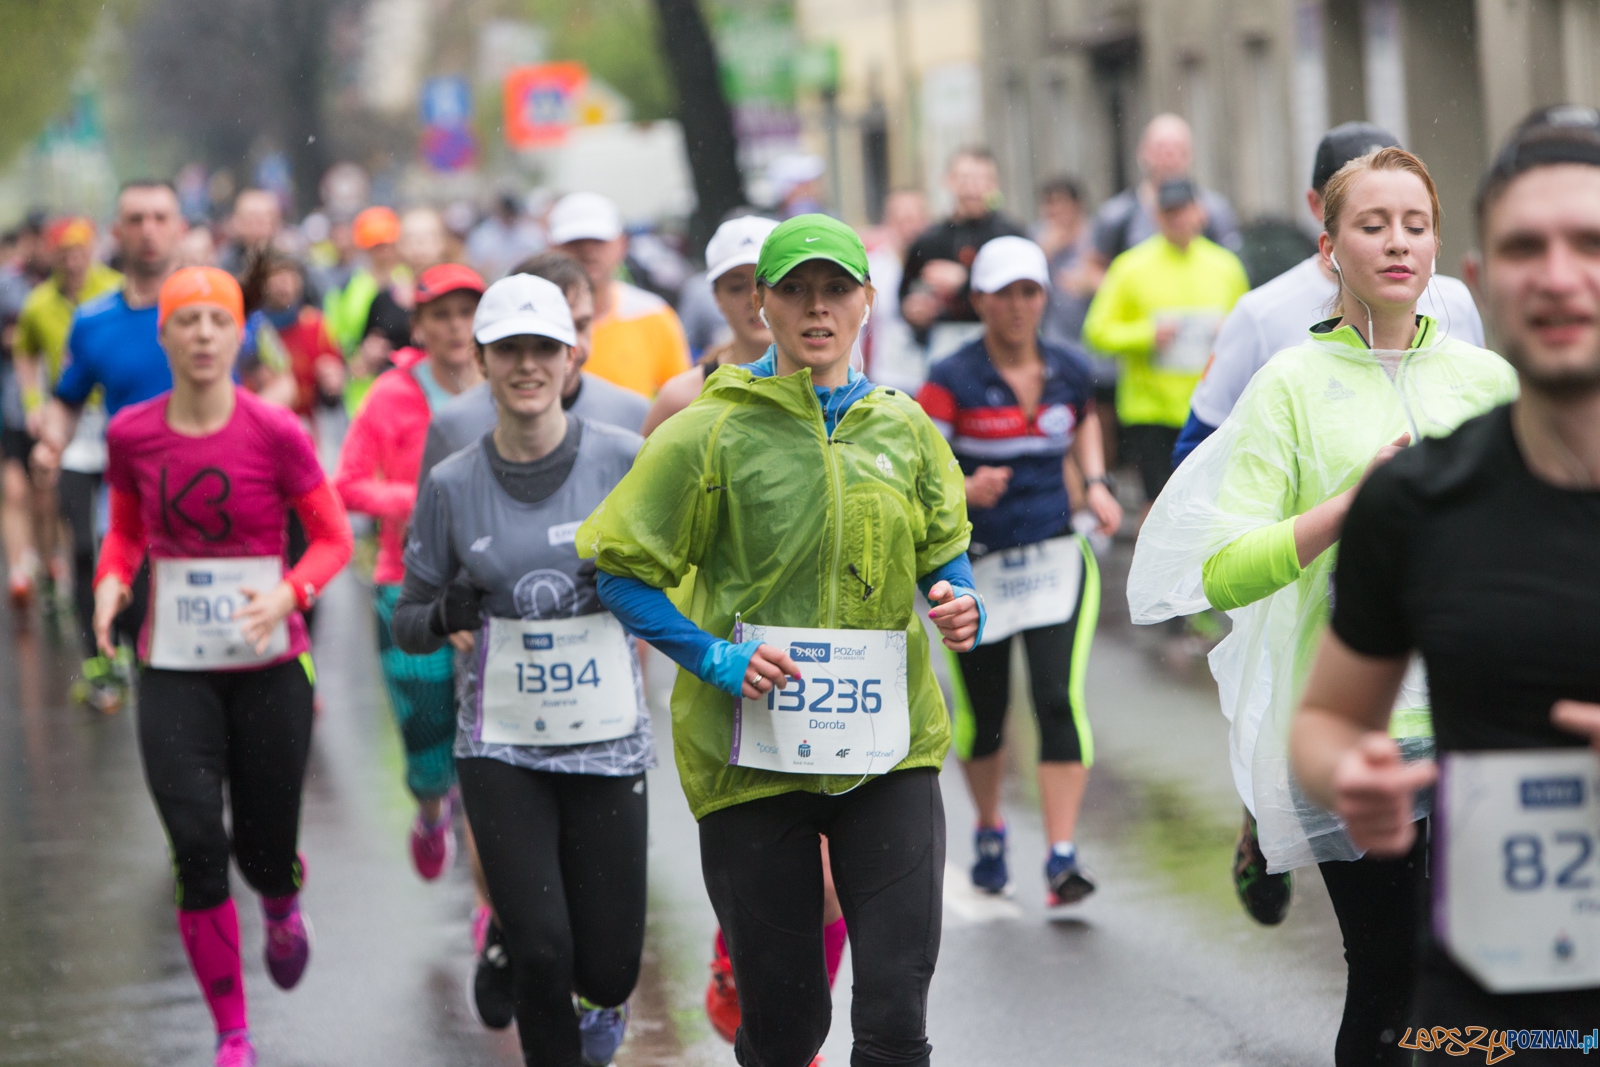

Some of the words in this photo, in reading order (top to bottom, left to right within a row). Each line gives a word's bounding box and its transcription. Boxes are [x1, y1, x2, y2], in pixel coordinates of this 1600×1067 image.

[516, 658, 601, 694] 1394
[767, 676, 882, 714] 13236
[809, 719, 846, 730] Dorota
[835, 748, 851, 758] 4F
